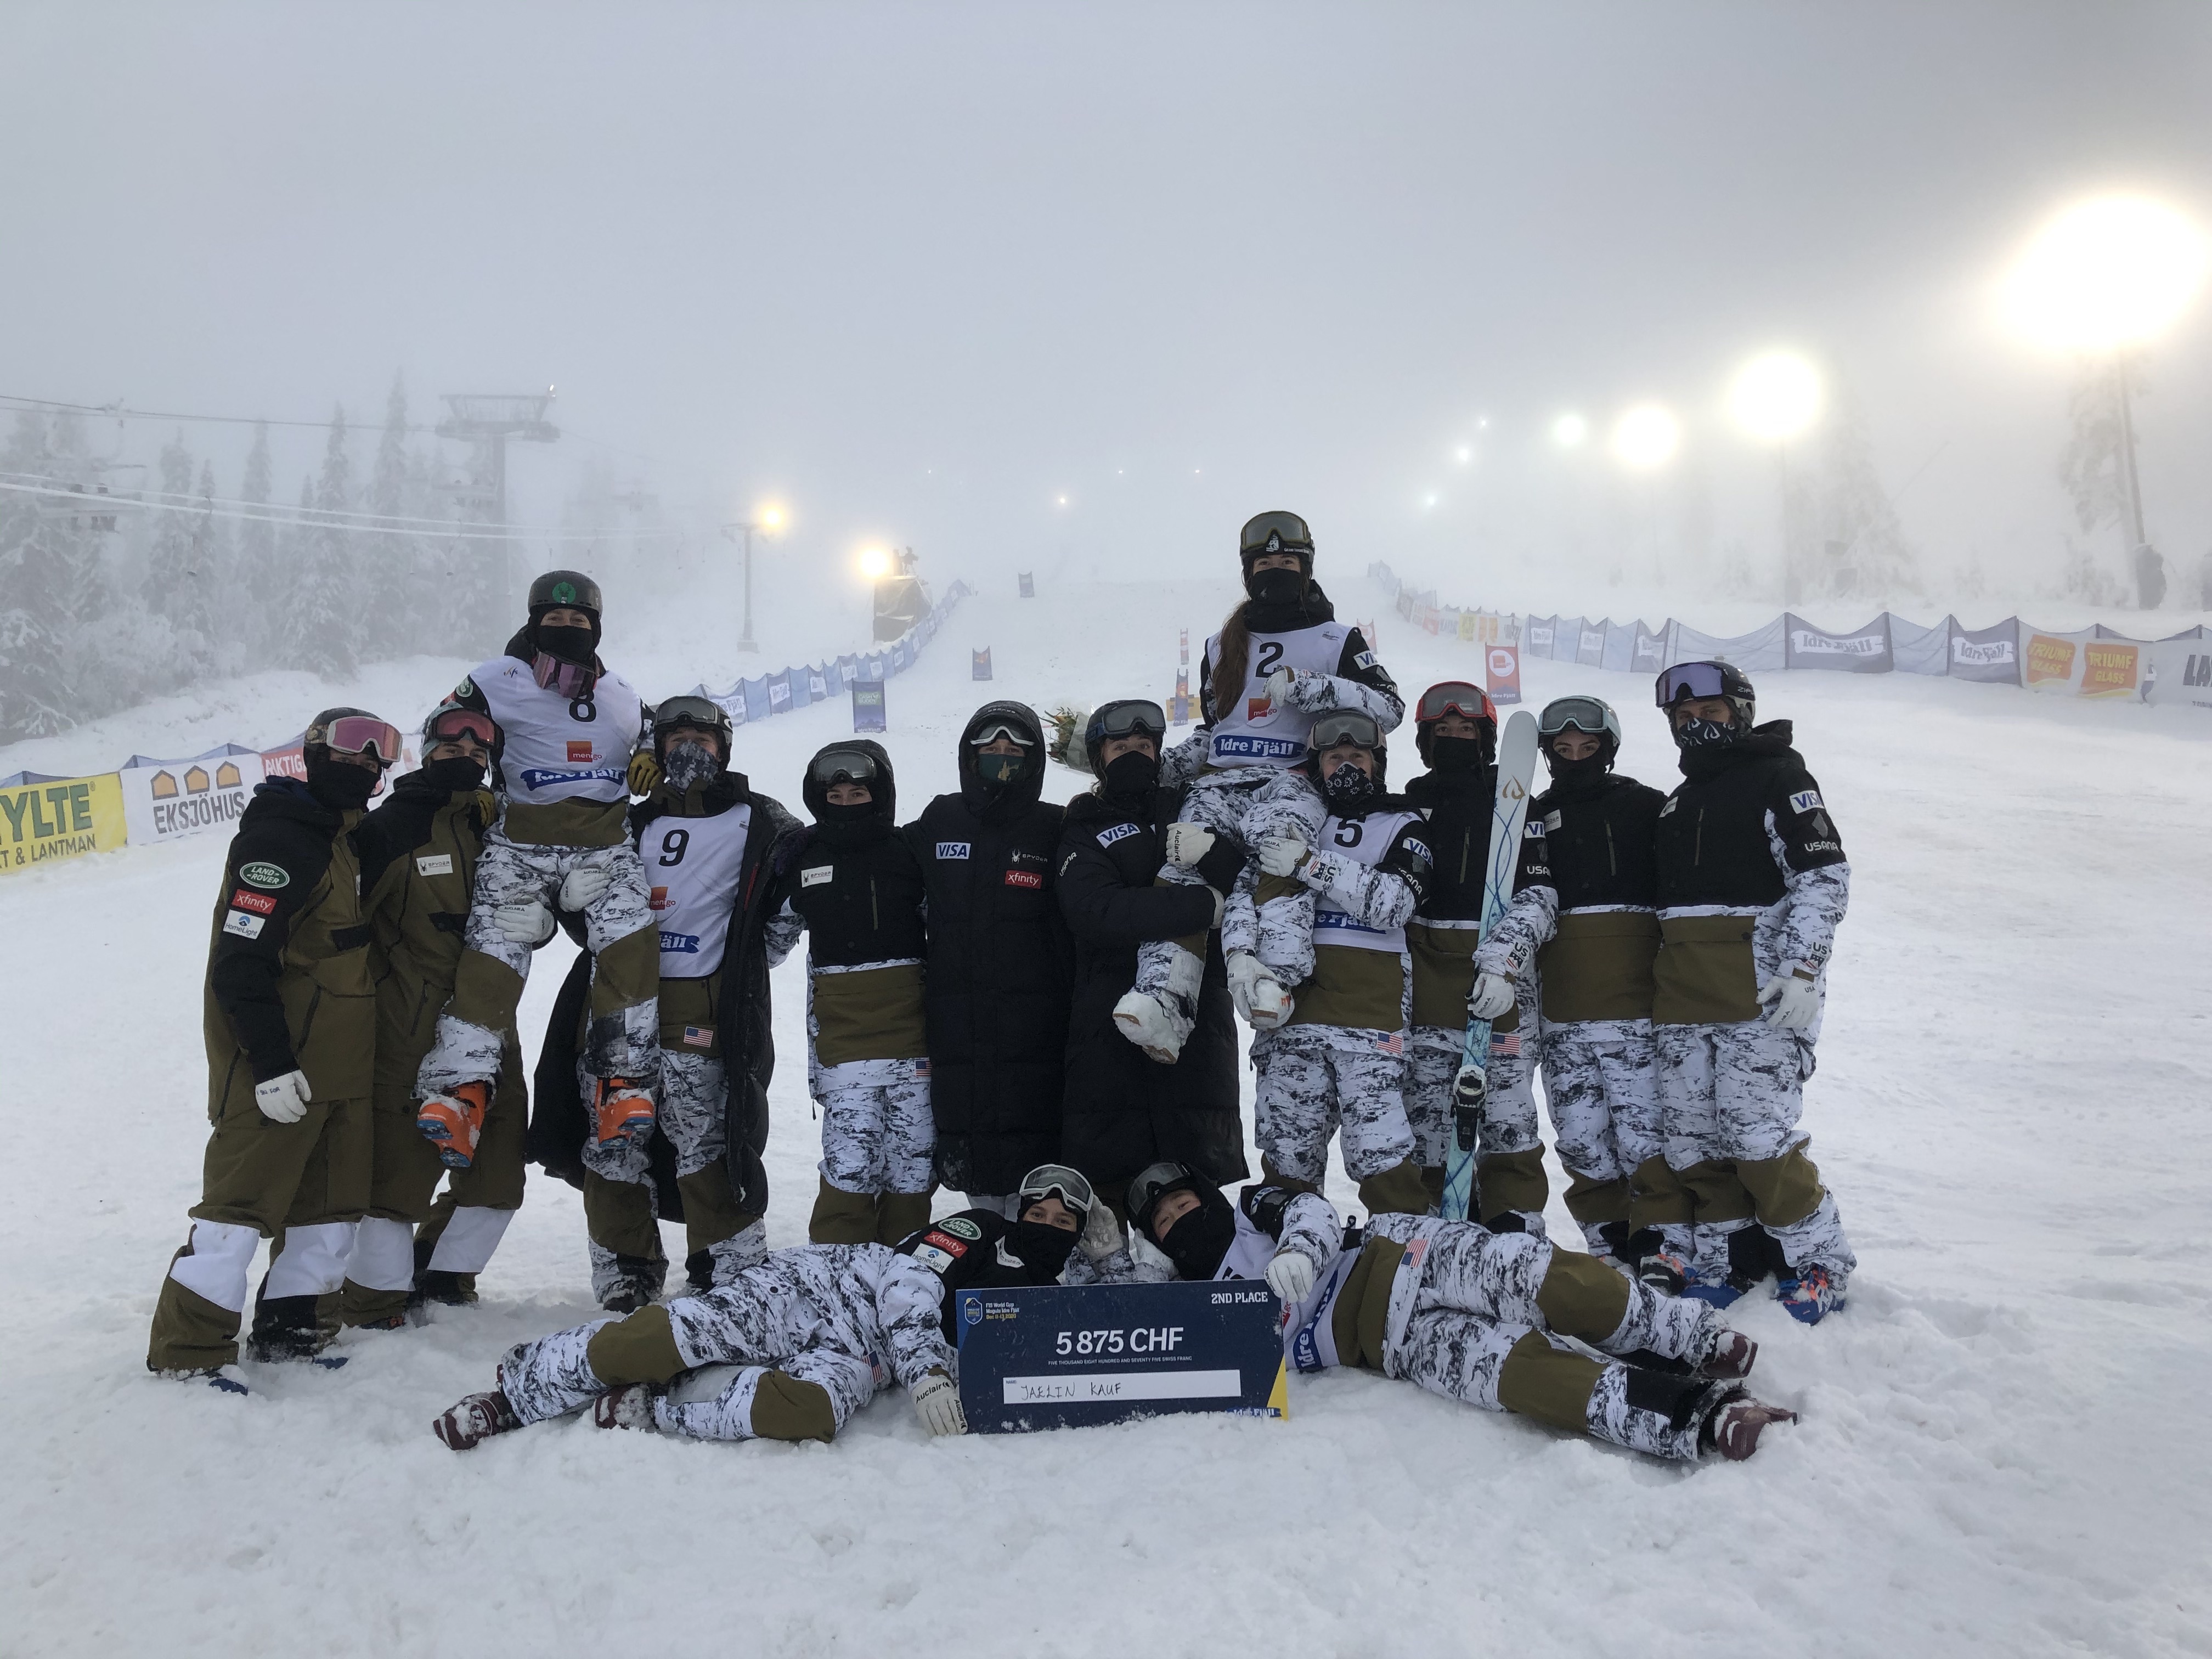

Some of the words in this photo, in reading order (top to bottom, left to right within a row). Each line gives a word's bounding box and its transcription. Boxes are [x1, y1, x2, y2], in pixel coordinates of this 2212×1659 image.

[1255, 641, 1284, 678] 2
[1356, 652, 1378, 665] VI
[2030, 642, 2073, 662] TRIUMF
[2088, 652, 2134, 669] TRIUMF
[2095, 670, 2125, 685] GLASS
[2183, 654, 2212, 687] LA
[569, 692, 597, 722] 8
[1220, 738, 1249, 751] Idre
[1251, 740, 1294, 756] Fjäll
[573, 752, 602, 760] menigo
[0, 783, 93, 845] YLTE
[153, 792, 245, 834] EKSJÖHUS
[1099, 823, 1138, 842] VISA
[1334, 819, 1363, 848] 5
[1527, 823, 1543, 836] VI
[15, 847, 25, 865] &
[31, 833, 96, 862] LANTMAN
[658, 829, 690, 867] 9
[938, 844, 967, 857] VISA
[1174, 830, 1182, 855] Auclair
[1804, 840, 1839, 852] USANA
[251, 866, 275, 876] LAND
[1059, 851, 1077, 877] USANA
[1527, 866, 1551, 876] USA
[250, 873, 280, 884] ROVER
[1008, 872, 1039, 885] xfinity
[236, 894, 272, 911] xfinity
[224, 922, 258, 936] HomeLight
[659, 934, 687, 949] äll
[1514, 941, 1528, 957] US
[1813, 941, 1828, 955] US
[1804, 985, 1816, 994] USA
[947, 1224, 972, 1237] ROVER
[949, 1219, 971, 1229] LAND
[929, 1233, 963, 1252] xfinity
[911, 1253, 945, 1271] HomeLight
[1211, 1293, 1232, 1304] 2ND
[1234, 1291, 1268, 1304] PLACE
[1130, 1327, 1184, 1353] CHF
[1298, 1333, 1316, 1368] Idre
[916, 1383, 942, 1405] Auclair
[1020, 1381, 1075, 1401] JAELIN
[1090, 1381, 1121, 1397] KAUF
[953, 1399, 964, 1423] Auclair
